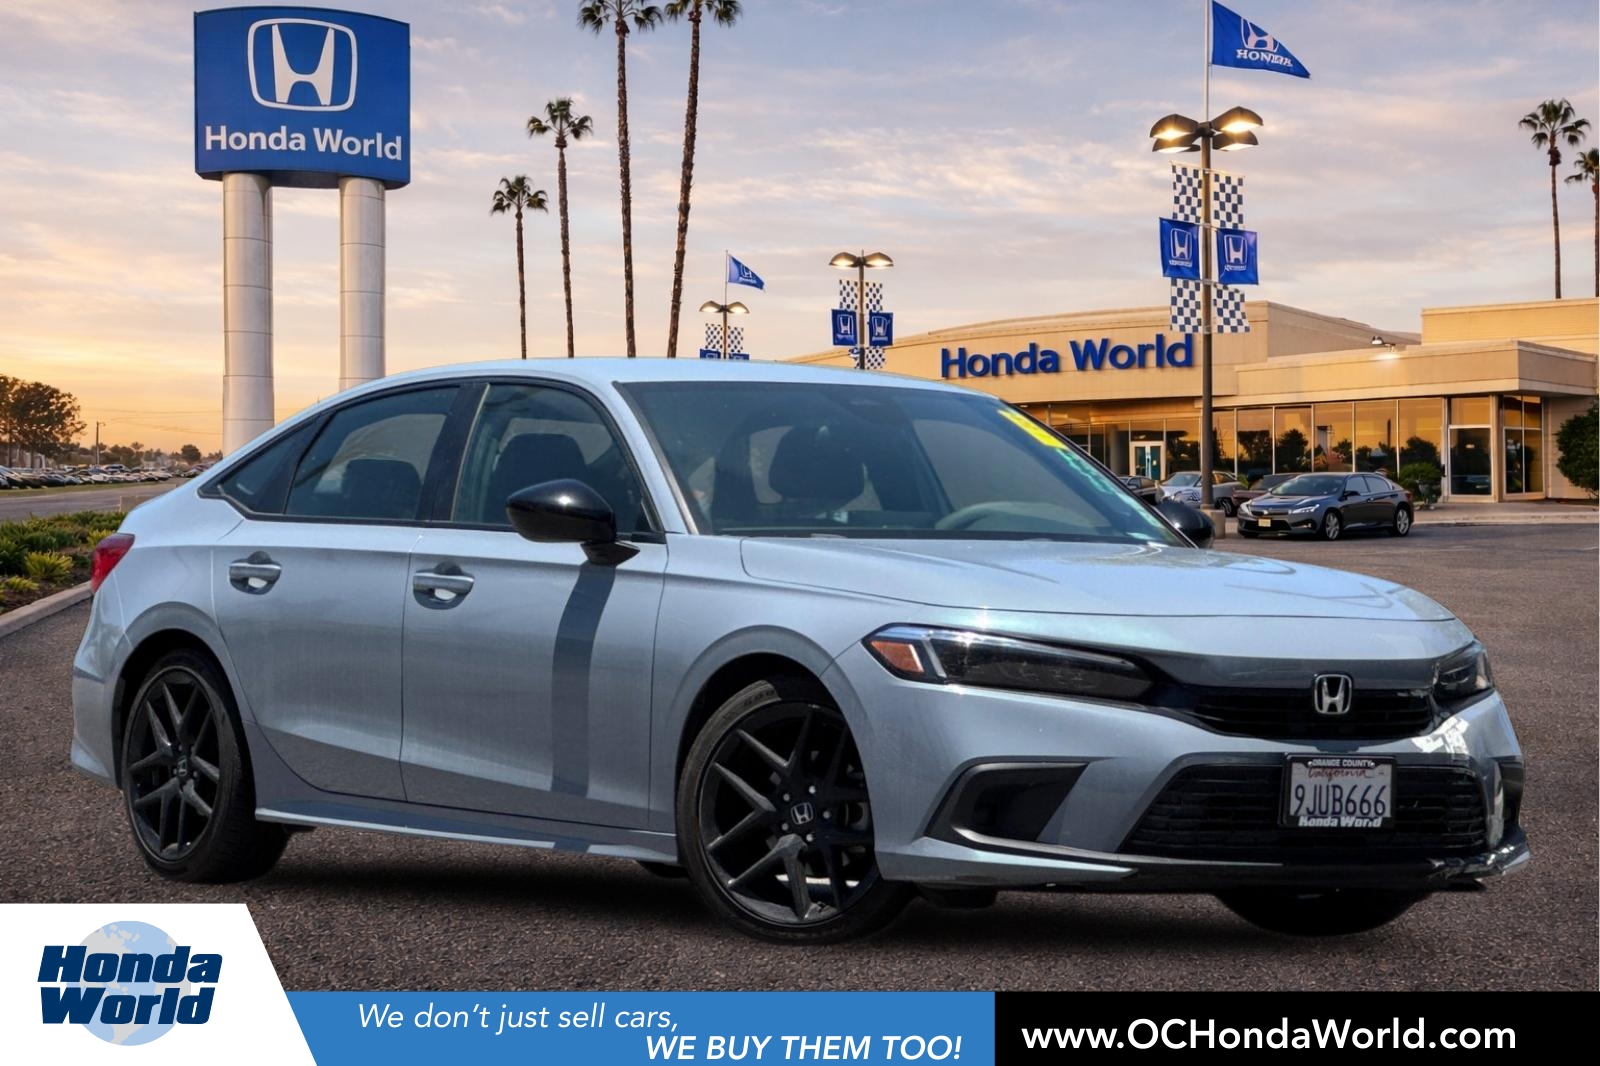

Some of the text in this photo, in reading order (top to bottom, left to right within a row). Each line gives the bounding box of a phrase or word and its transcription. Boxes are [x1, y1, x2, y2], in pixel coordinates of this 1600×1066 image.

[205, 125, 403, 161] Honda World
[941, 333, 1194, 378] Honda World
[1342, 759, 1373, 767] COUNTY
[1294, 784, 1386, 816] 9JUB666
[1298, 816, 1382, 828] Honda World
